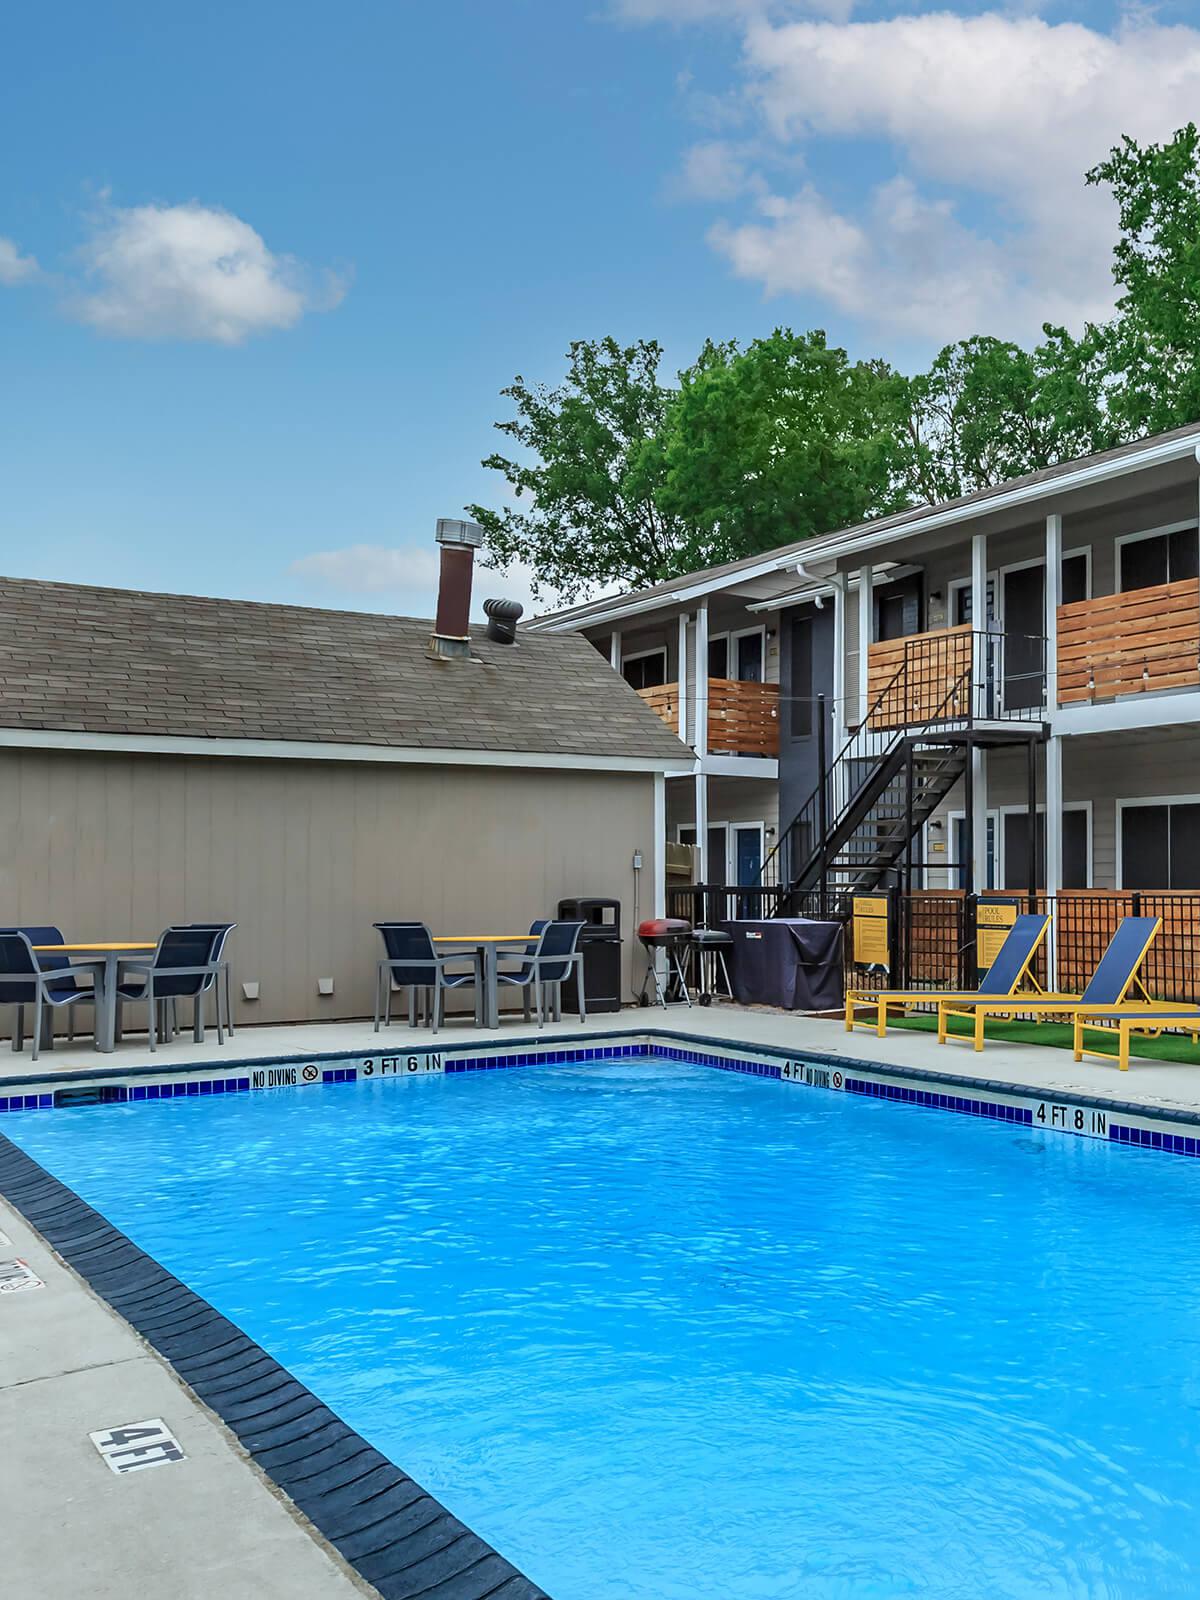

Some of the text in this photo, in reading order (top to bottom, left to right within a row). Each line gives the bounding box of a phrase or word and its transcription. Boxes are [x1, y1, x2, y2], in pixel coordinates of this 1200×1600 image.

[363, 1054, 441, 1075] 3 FT 6 IN
[783, 1061, 790, 1078] 4
[793, 1063, 805, 1080] FT
[253, 1068, 297, 1087] NO DIVING
[1036, 1103, 1106, 1135] 4 FT 8 IN
[100, 1427, 164, 1447] 4
